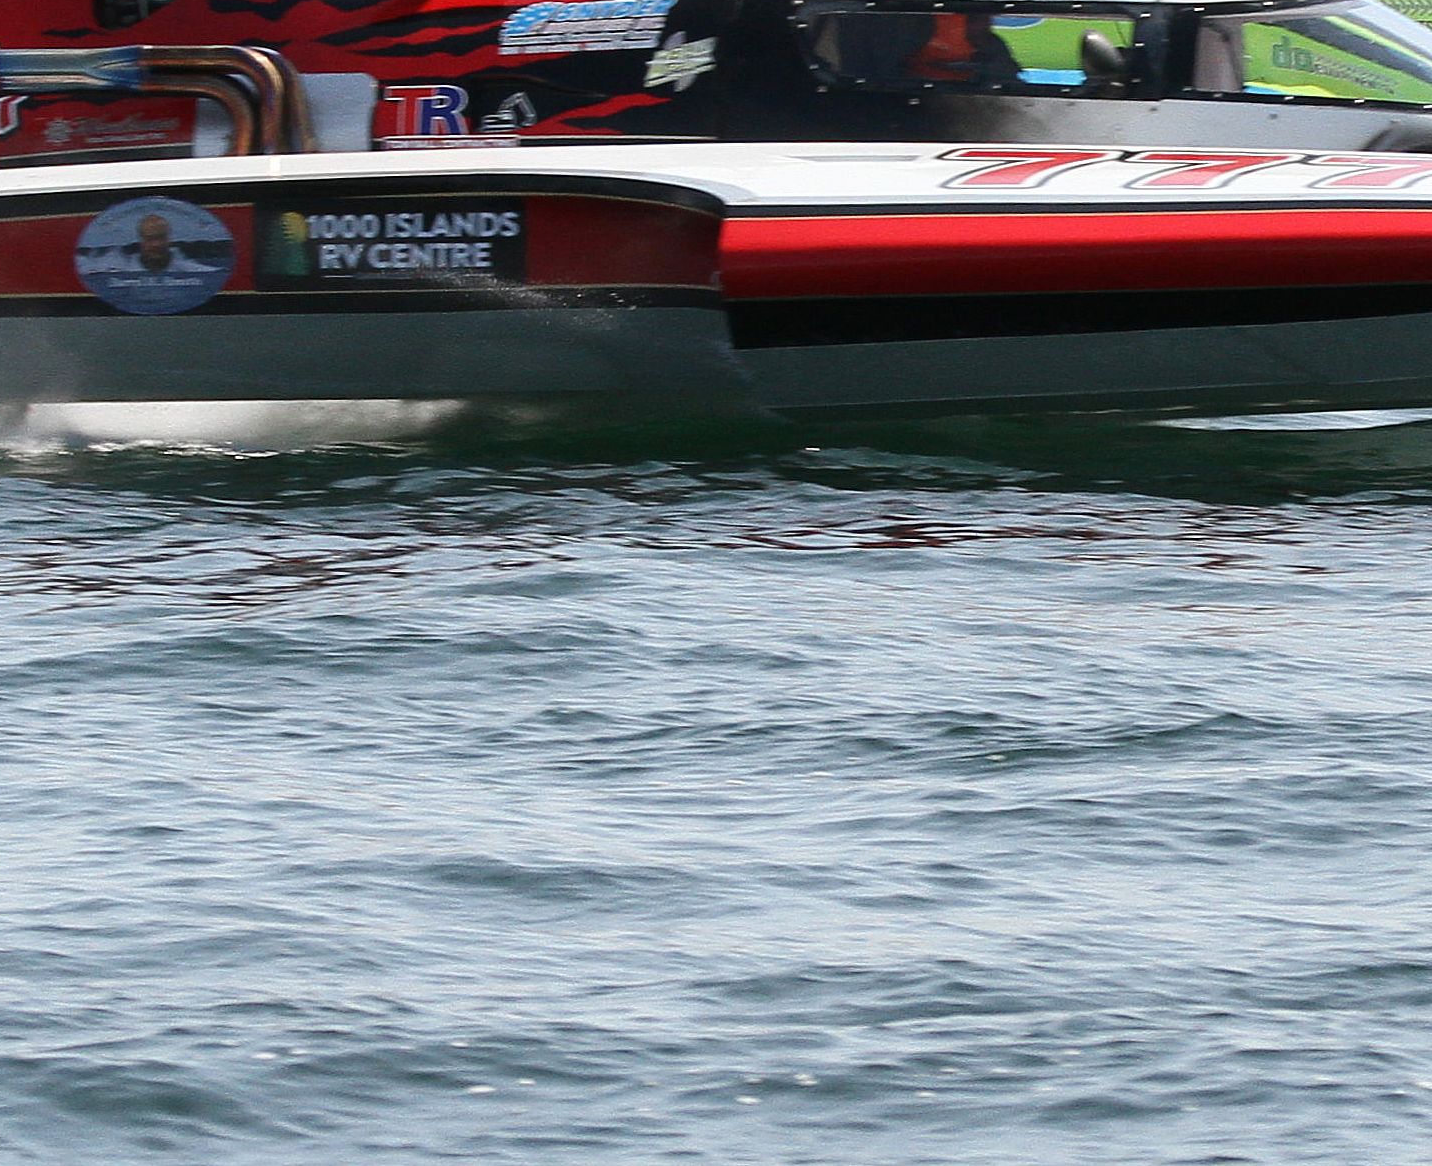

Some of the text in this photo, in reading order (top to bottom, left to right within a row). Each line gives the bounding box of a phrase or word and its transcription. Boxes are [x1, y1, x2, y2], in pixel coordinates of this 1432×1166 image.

[384, 85, 469, 135] TR
[306, 212, 520, 239] 1000 ISLANDS
[320, 241, 493, 269] RV CENTRE
